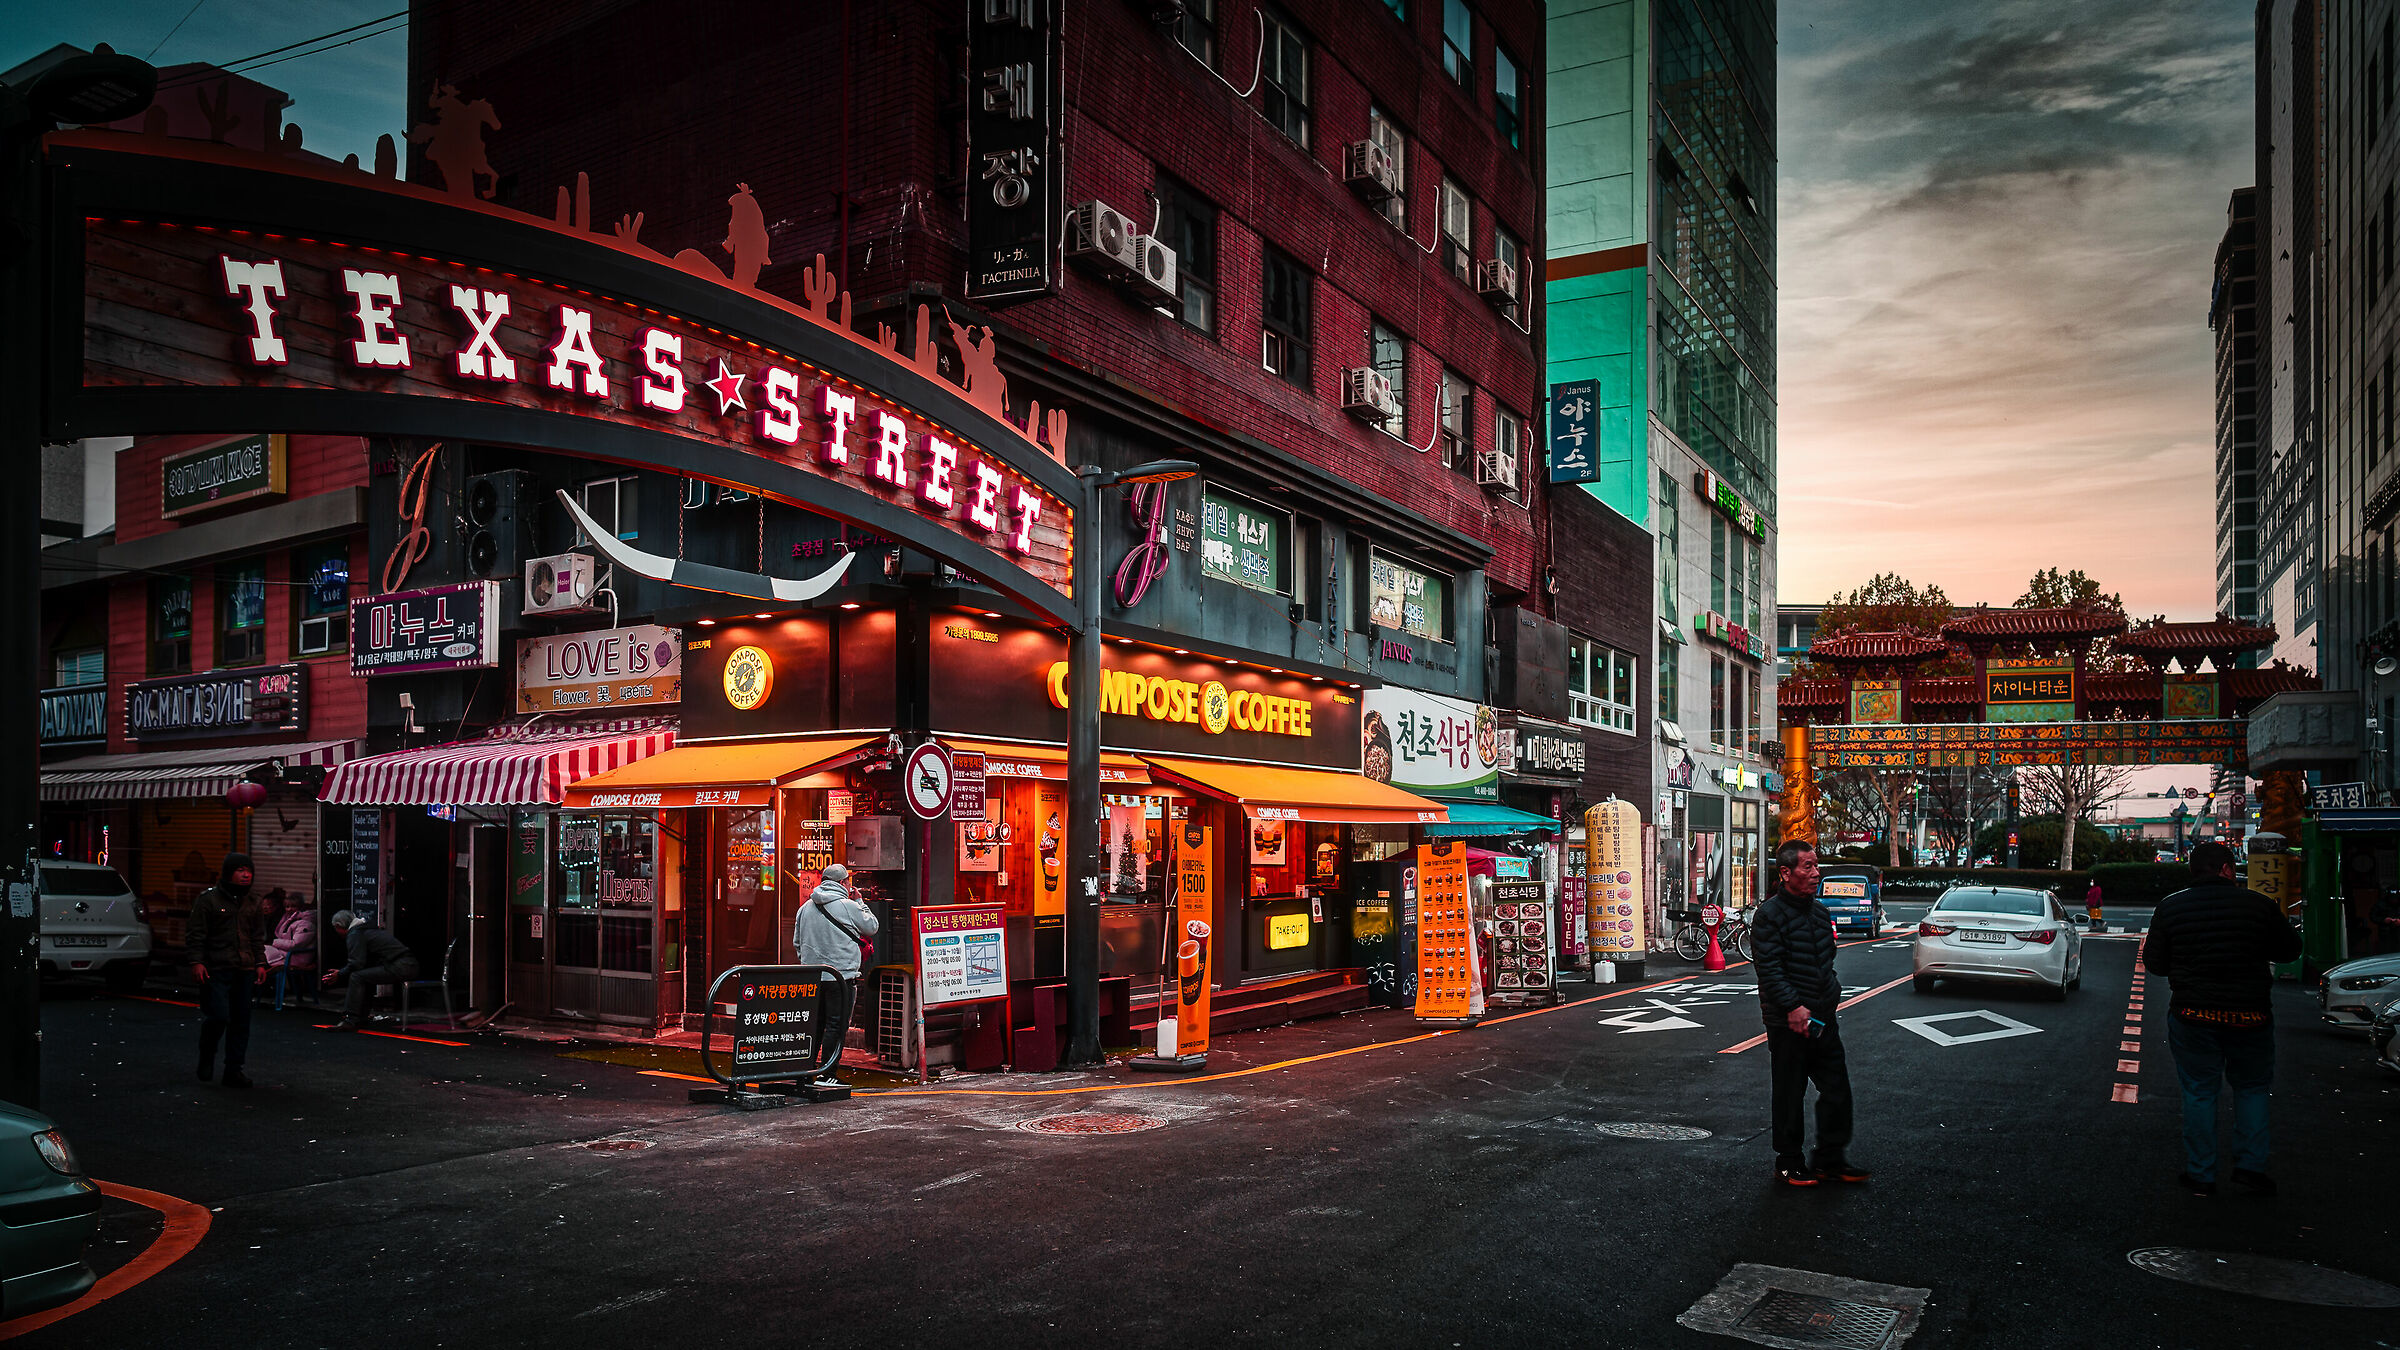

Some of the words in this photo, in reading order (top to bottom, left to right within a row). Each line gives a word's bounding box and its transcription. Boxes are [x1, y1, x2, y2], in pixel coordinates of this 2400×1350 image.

[1567, 385, 1592, 395] Janus
[219, 254, 689, 414] TEXAS
[757, 365, 1042, 557] STREET
[1556, 397, 1592, 470] 야누스
[227, 443, 262, 484] КАФЕ
[1580, 469, 1592, 478] 2F
[1175, 508, 1196, 526] КАФЕ
[1175, 523, 1195, 540] ЯНУС
[1237, 513, 1269, 551] 위스키
[791, 539, 824, 558] 초량점
[1175, 538, 1191, 552] БАР
[1240, 548, 1270, 584] 생맥주
[370, 597, 455, 650] 야누스
[457, 621, 476, 640] 커피
[546, 636, 620, 681] LOVE
[627, 632, 650, 673] is
[1381, 639, 1413, 664] JANUS
[728, 650, 764, 676] COMPOSE
[620, 684, 653, 701] цветы
[729, 687, 761, 705] COFFEE
[1992, 679, 2069, 696] 차이나타운
[133, 681, 245, 729] ОК.МАГАЗИН
[1047, 661, 1200, 724] CMPOSE
[1228, 690, 1312, 738] COFFEE
[1396, 709, 1473, 770] 천초식당
[1017, 764, 1043, 777] COFFEE
[1100, 769, 1113, 780] 포즈
[1113, 770, 1128, 781] 커피
[590, 793, 632, 807] COMPOSE
[632, 793, 662, 806] COFFEE
[695, 790, 721, 805] 컴포즈
[721, 790, 740, 804] 커피
[2315, 786, 2360, 808] 주차장
[1256, 807, 1282, 819] COMPOSE
[1282, 809, 1300, 819] COFFEE
[325, 840, 351, 855] ЗОЛУ
[729, 844, 764, 856] COMPOSE
[801, 840, 833, 851] 아메리카노
[1182, 873, 1205, 893] 1500
[1565, 881, 1573, 901] 미래
[1498, 886, 1539, 899] 천초식당
[923, 915, 949, 930] 청소년
[951, 912, 998, 929] 통행제한구역
[1275, 924, 1304, 936] TAKE-OUT
[1564, 903, 1574, 949] MOTEL
[758, 983, 818, 999] 차량통행제한
[743, 1011, 768, 1026] 홍성방
[778, 1010, 810, 1024] 국민은행
